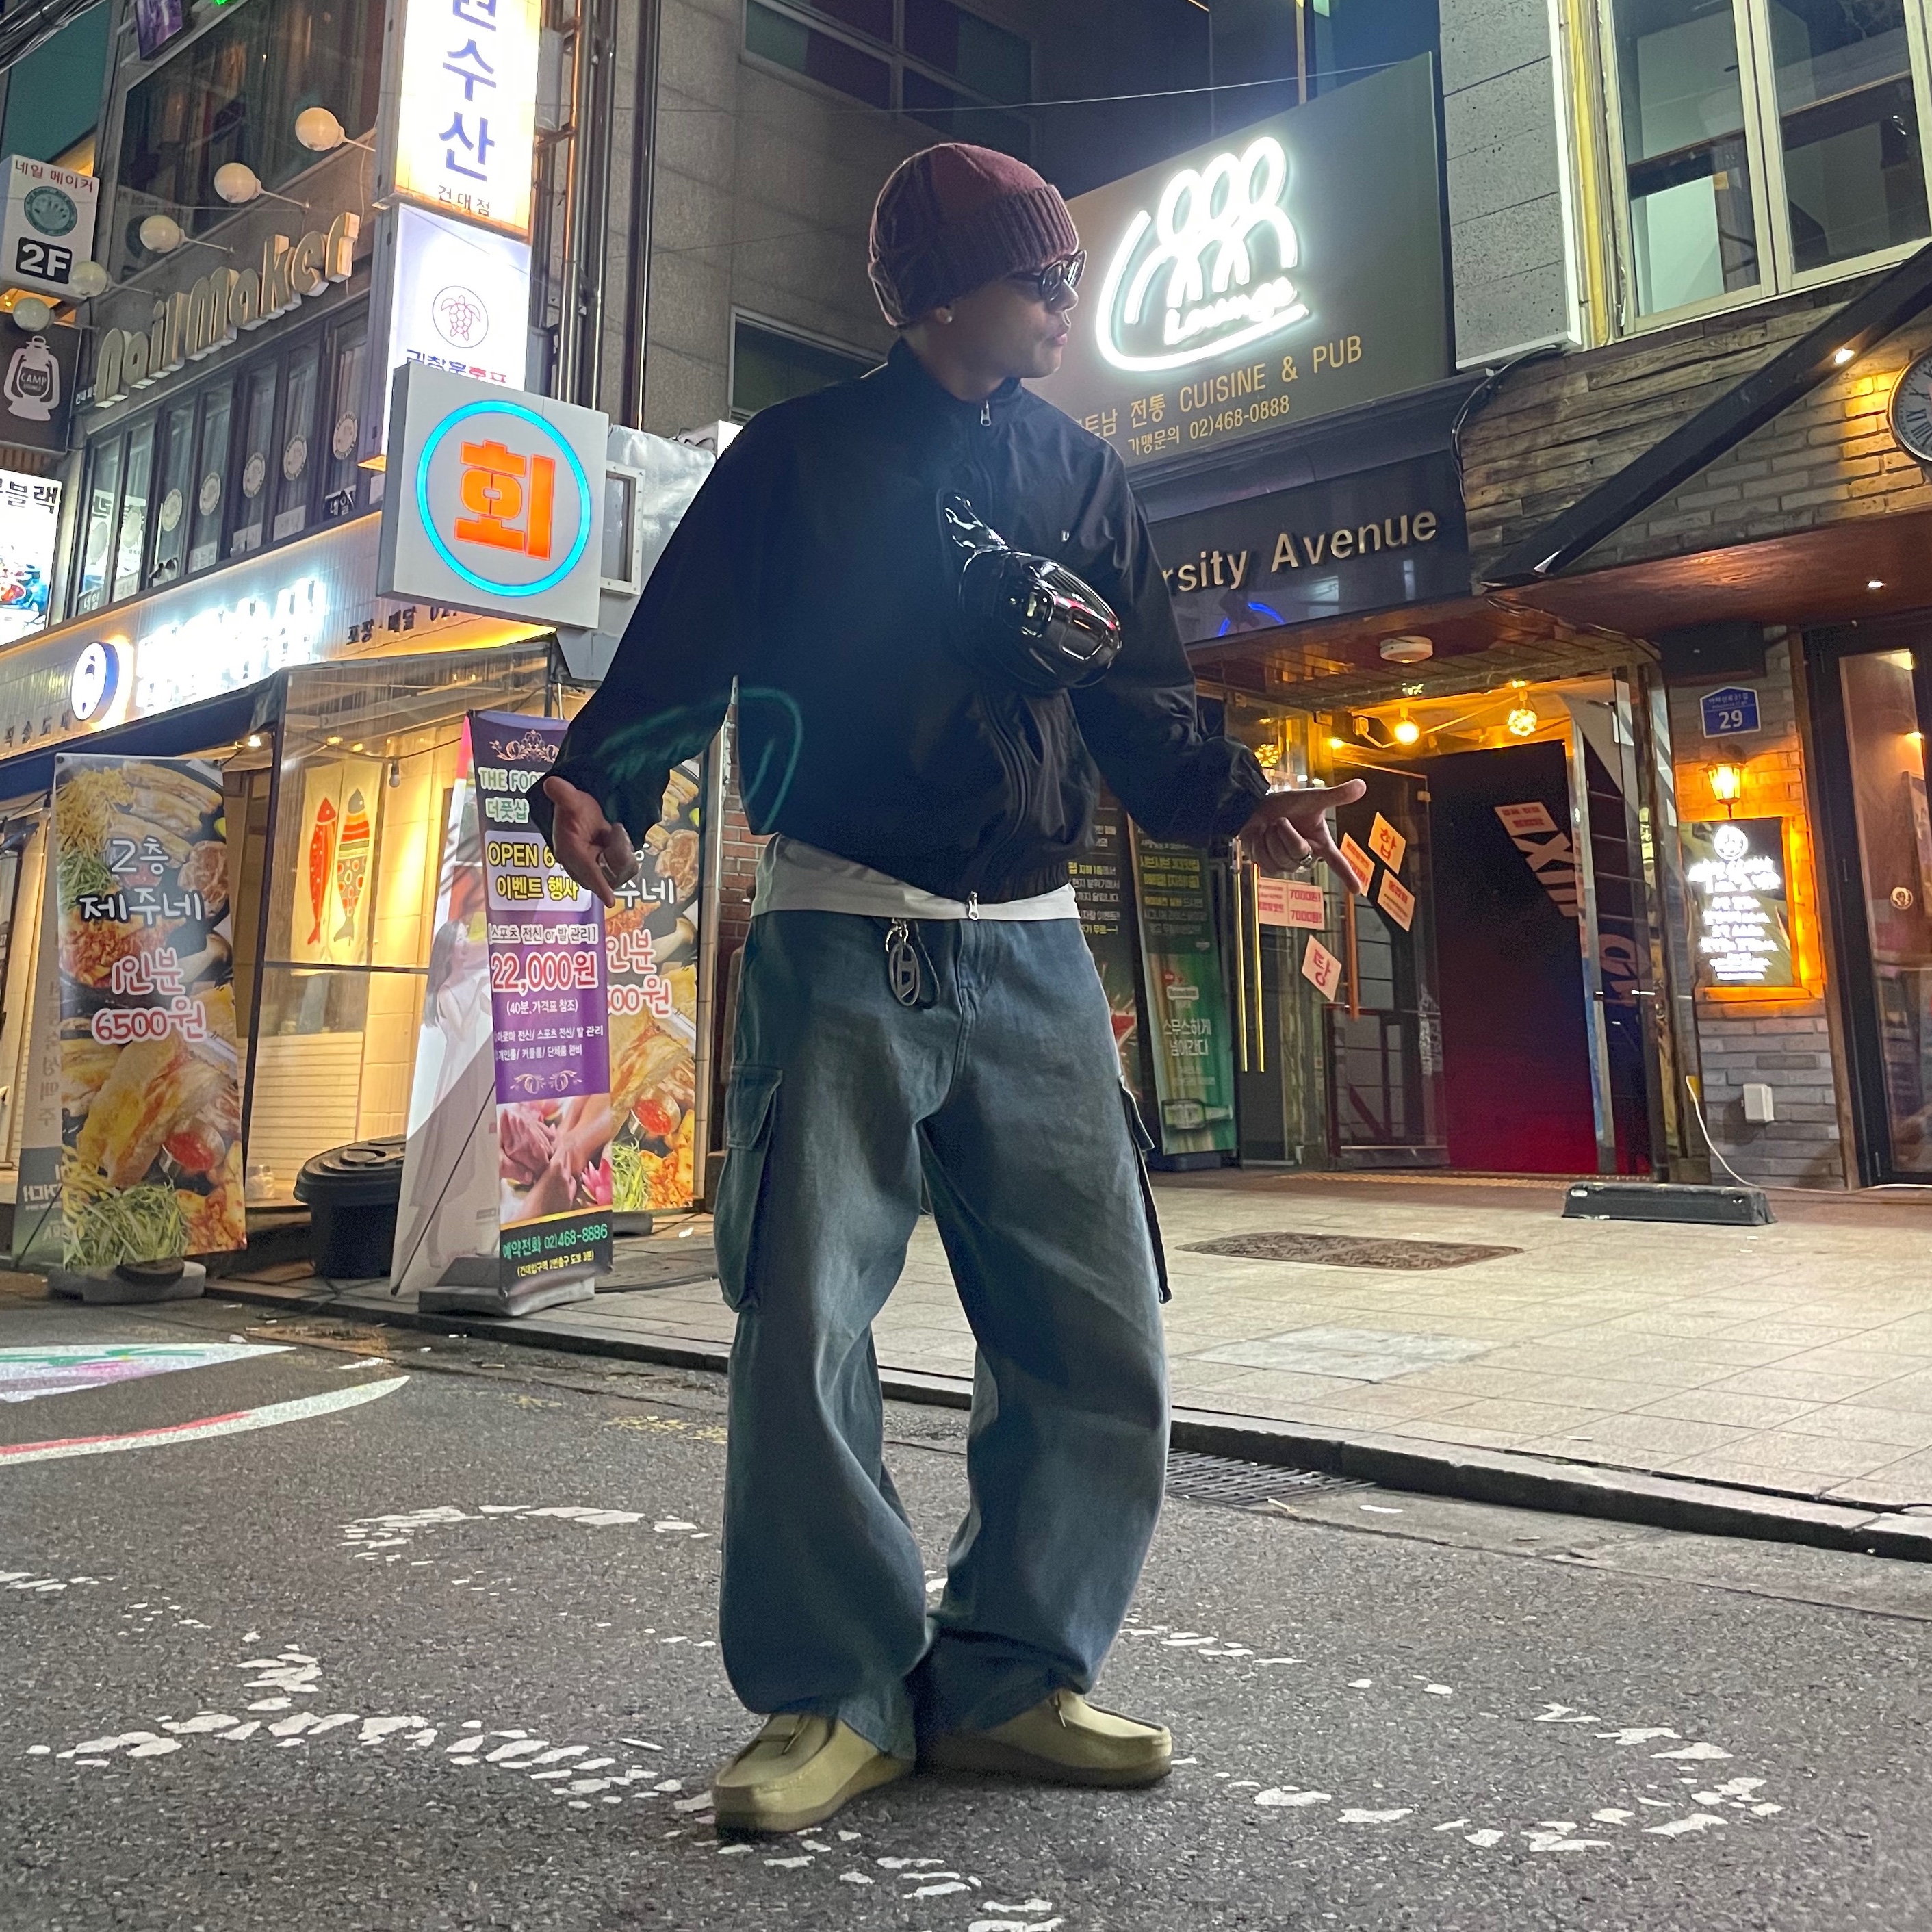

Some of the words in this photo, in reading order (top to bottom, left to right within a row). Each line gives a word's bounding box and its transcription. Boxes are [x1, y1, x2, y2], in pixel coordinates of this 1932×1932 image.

[15, 159, 43, 179] 네일
[50, 170, 94, 193] 메이커
[439, 185, 491, 217] 건대점
[21, 243, 70, 277] 2F
[21, 372, 47, 385] CAMP
[1079, 408, 1118, 437] 트남
[1131, 393, 1166, 428] 전통
[1179, 363, 1266, 411] CUISINE
[1281, 355, 1298, 383] &
[1313, 335, 1362, 374] PUB
[1127, 425, 1180, 456] 가맹문의
[1189, 394, 1290, 439] 02)468-0888
[454, 439, 556, 561] 회
[1271, 509, 1437, 572] Avenue
[1718, 710, 1743, 730] 29
[480, 770, 506, 788] THE
[111, 838, 170, 875] 2층
[488, 842, 539, 867] OPEN
[497, 875, 544, 901] 이벤트
[548, 877, 578, 901] 행사
[613, 878, 674, 908] 주네
[80, 887, 203, 925] 제주네
[523, 926, 543, 942] 전신
[545, 931, 555, 941] or
[558, 927, 567, 942] 발
[571, 926, 596, 942] 관리]
[606, 931, 654, 971] 인분
[491, 954, 596, 992] 22,000원
[1313, 949, 1332, 987] 탕
[559, 999, 578, 1013] 참조)
[608, 977, 669, 1015] 00원
[94, 999, 204, 1040] 6500원
[537, 1029, 557, 1039] 스포츠
[586, 1025, 604, 1037] 관리
[502, 1235, 541, 1260] 예약전화
